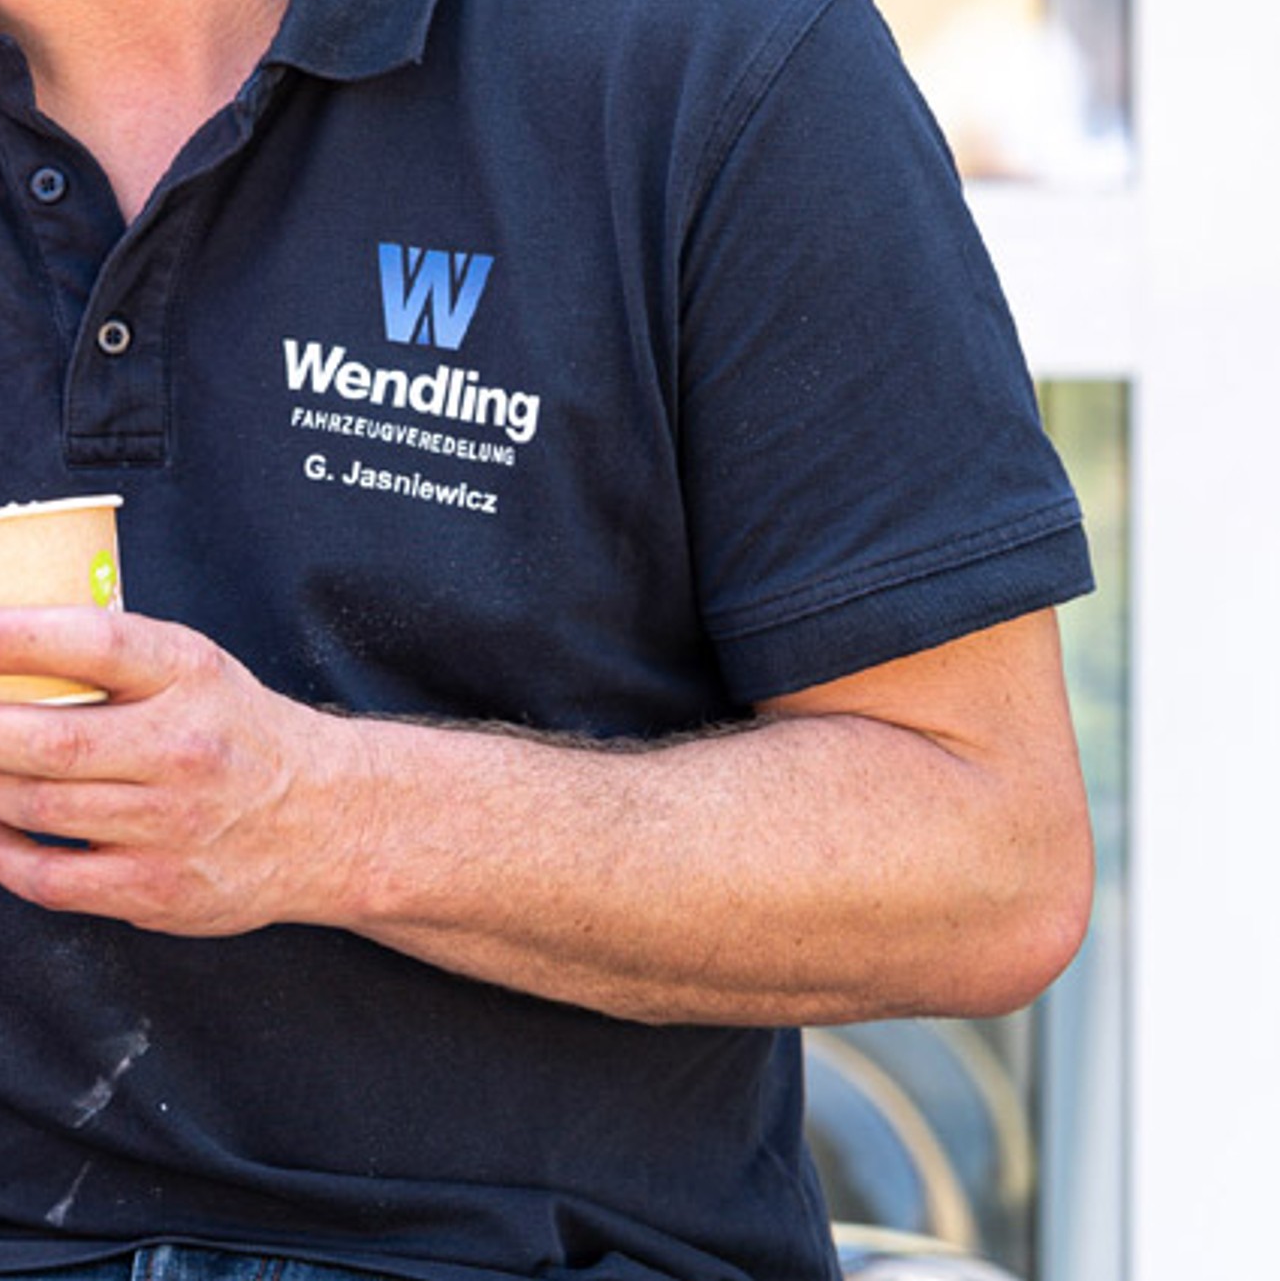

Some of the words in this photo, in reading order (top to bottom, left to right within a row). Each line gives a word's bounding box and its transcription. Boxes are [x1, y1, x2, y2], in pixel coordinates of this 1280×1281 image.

[283, 338, 541, 443] Wendling
[291, 407, 516, 466] FAHRZEUGVEREDELUNG
[304, 454, 335, 482] G.
[342, 461, 498, 514] Jasniewicz
